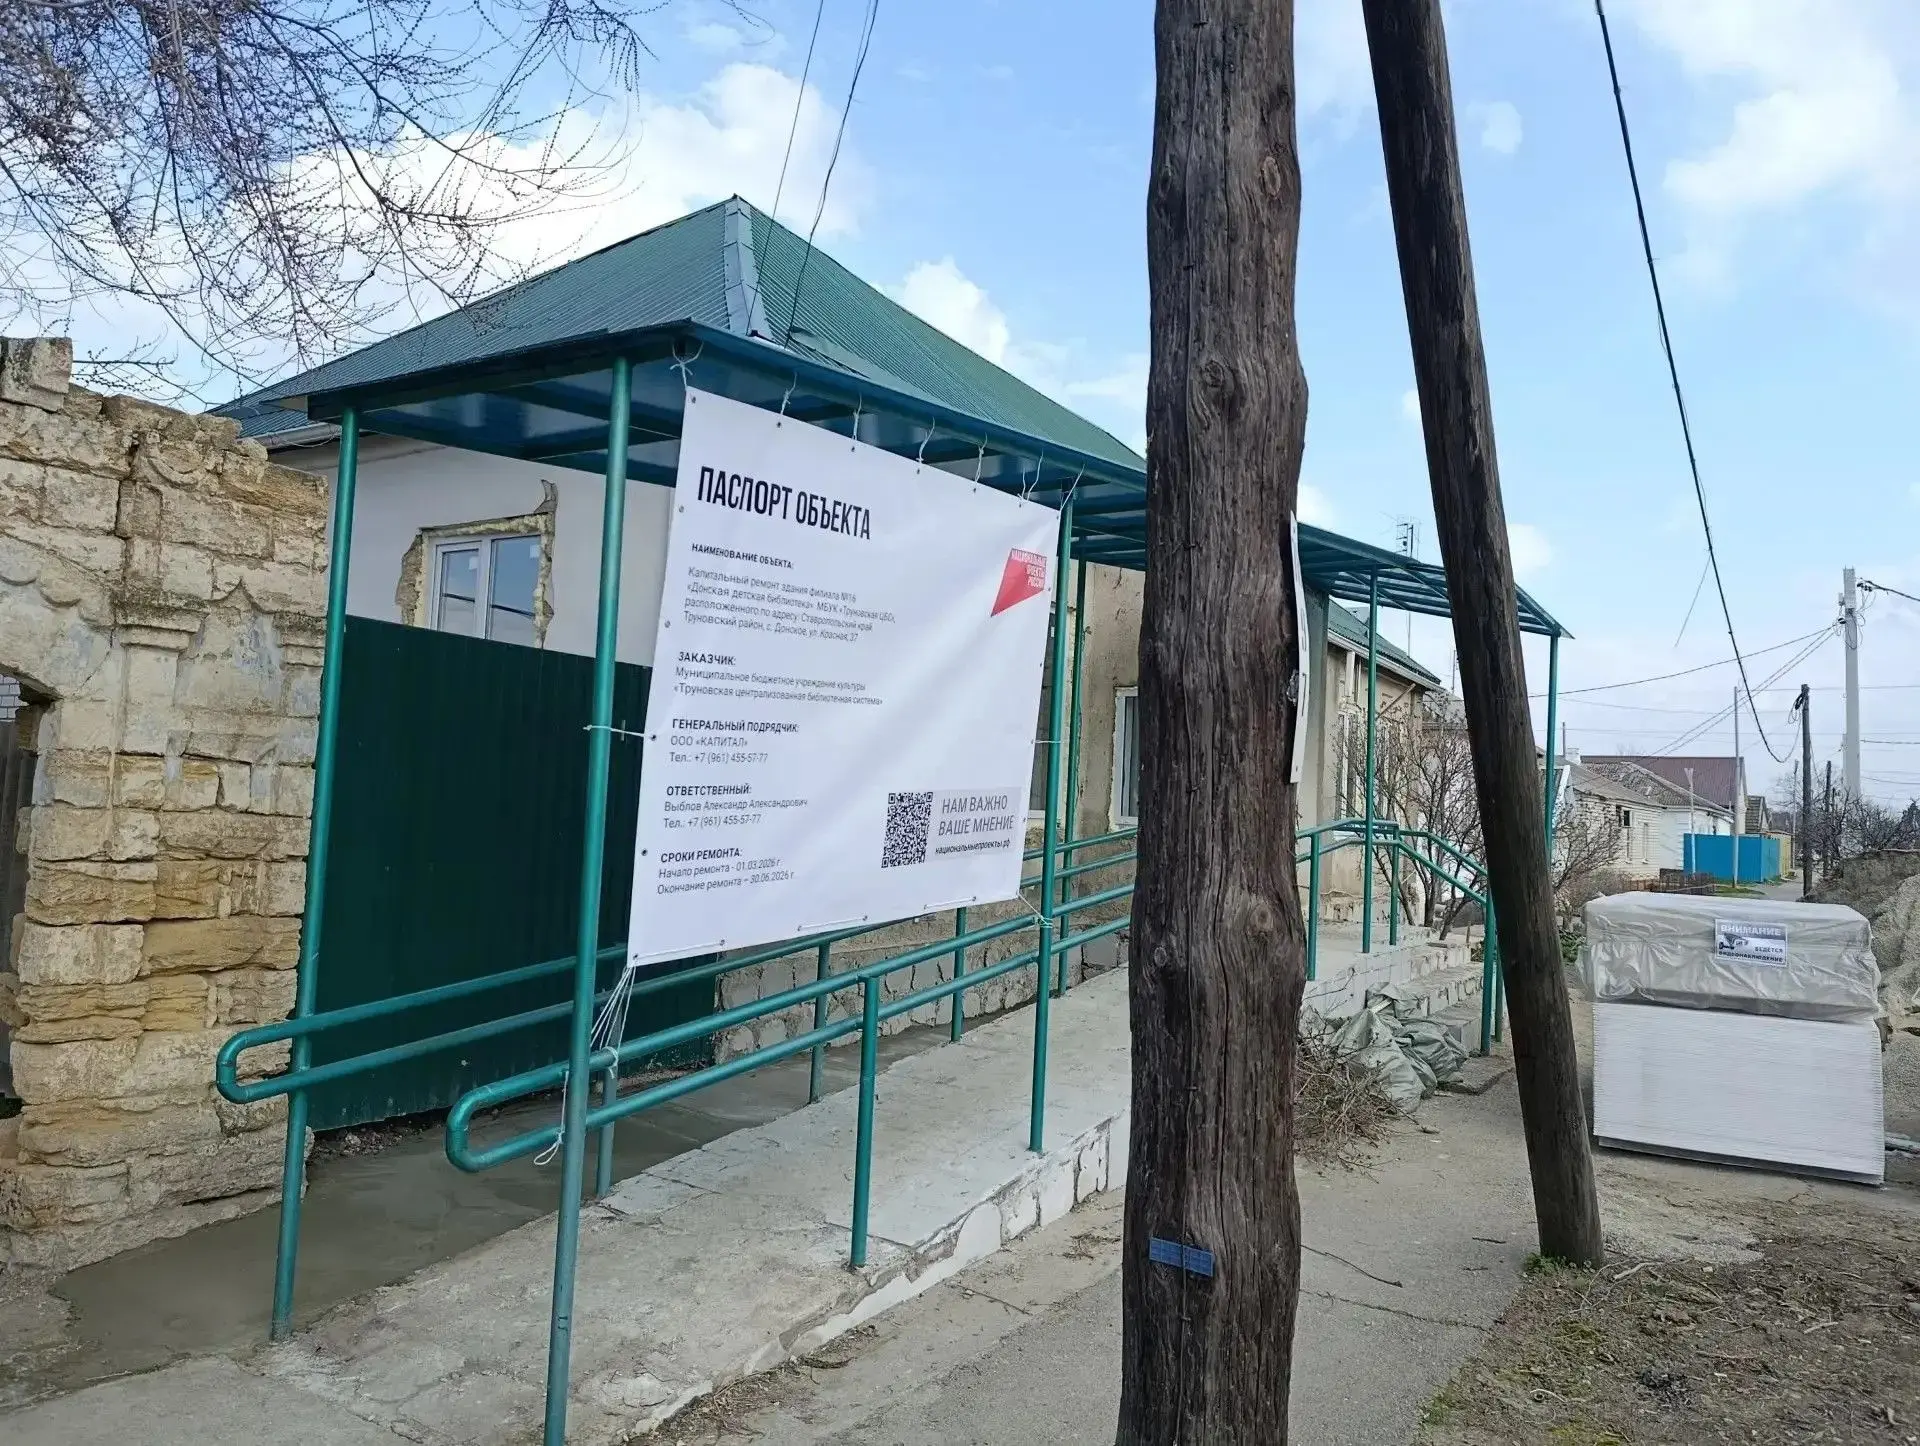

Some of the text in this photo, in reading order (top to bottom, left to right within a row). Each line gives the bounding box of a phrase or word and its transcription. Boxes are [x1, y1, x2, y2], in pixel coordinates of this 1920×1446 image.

[698, 465, 871, 540] ПАСПОРТ ОБЪЕКТА
[692, 543, 794, 569] НАИМЕНОВАНИЕ ОБЪЕКТА:
[688, 567, 749, 584] Капитальный
[750, 578, 780, 590] ремонт
[781, 584, 808, 595] здания
[687, 582, 729, 597] «Донская
[731, 590, 766, 602] детская
[816, 602, 838, 613] МБУК
[684, 611, 737, 625] Труновский
[760, 608, 771, 617] по
[678, 652, 737, 666] ЗАКАЗЧИК:
[675, 666, 750, 682] Муниципальное
[751, 673, 795, 685] бюджетное
[674, 682, 734, 696] «Труновская
[672, 718, 799, 735] ГЕНЕРАЛЬНЫЙ ПОДРЯДЧИК:
[670, 735, 749, 748] ООО «КАПИТАЛ»
[694, 752, 706, 763] +7
[707, 752, 729, 765] (961)
[730, 753, 769, 764] 455-57-77
[666, 783, 752, 796] ОТВЕТСТВЕННЫЙ:
[664, 799, 808, 813] Выблов Александр Александрович
[942, 795, 1008, 814] НАМ ВАЖНО
[687, 817, 700, 828] +7
[700, 816, 721, 828] (961)
[722, 814, 762, 825] 455-57-77
[938, 814, 1014, 836] ВАШЕ МНЕНИЕ
[660, 847, 743, 864] СРОКИ РЕМОНТА:
[659, 867, 693, 879] Начало
[693, 863, 731, 877] ремонта
[657, 880, 706, 895] Окончание
[706, 877, 743, 891] ремонта
[1720, 924, 1782, 936] ВНИМАНИЕ
